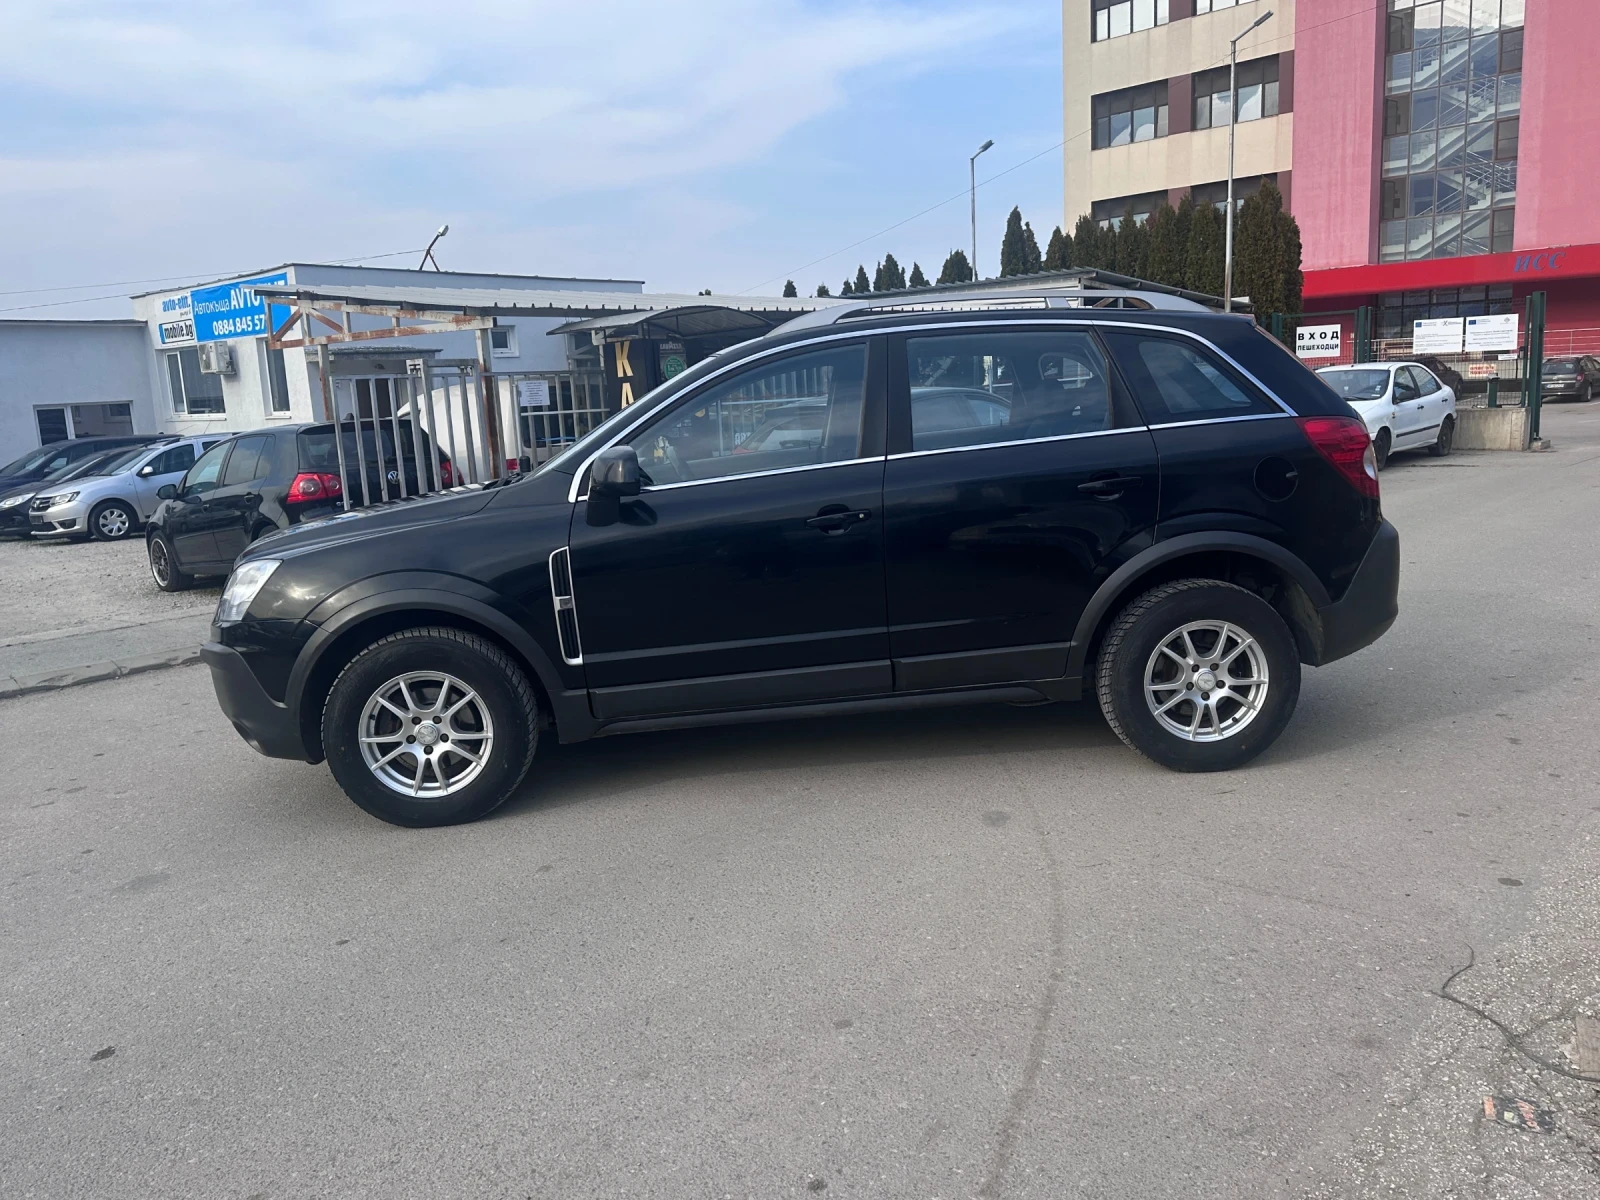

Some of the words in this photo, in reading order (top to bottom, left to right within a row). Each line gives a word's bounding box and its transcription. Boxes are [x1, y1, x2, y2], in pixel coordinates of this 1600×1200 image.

[1514, 251, 1567, 273] ИСС
[194, 299, 230, 315] Автокъща
[163, 322, 194, 339] mobile.bg
[212, 319, 234, 335] 0884
[235, 316, 253, 332] 845
[1297, 330, 1340, 341] ВХОД
[1297, 343, 1339, 351] ПЕШЕХОДЦИ
